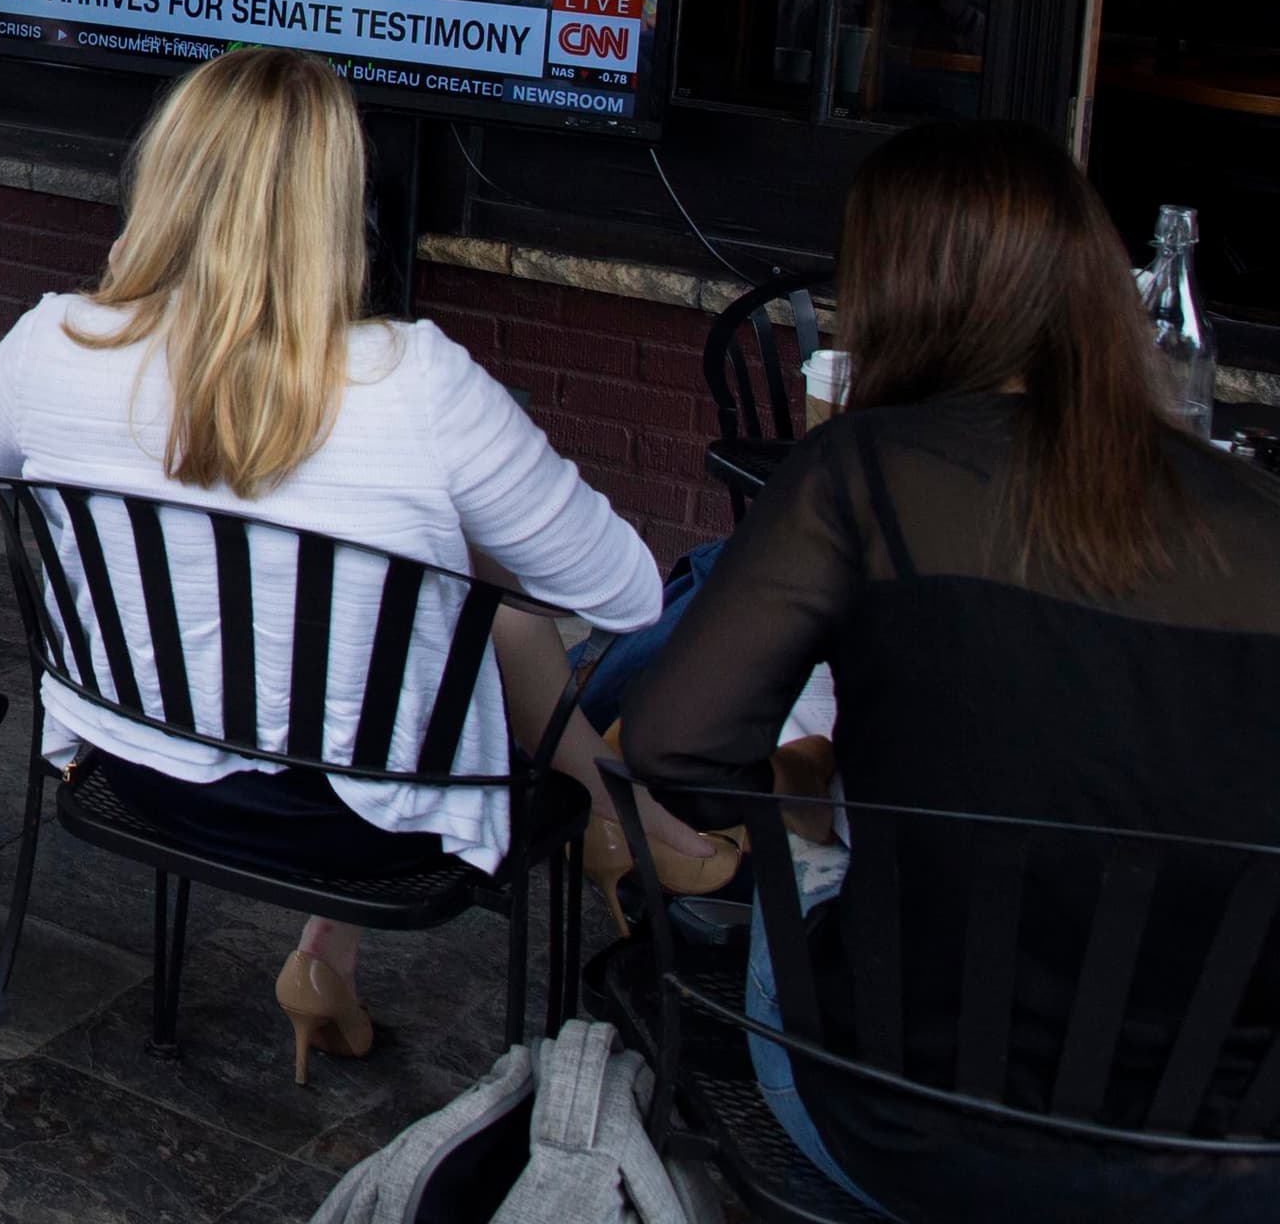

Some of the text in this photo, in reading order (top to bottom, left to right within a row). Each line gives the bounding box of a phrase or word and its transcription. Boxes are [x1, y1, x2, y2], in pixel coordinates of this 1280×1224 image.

[352, 6, 531, 56] TESTIMONY
[557, 22, 629, 61] CNN
[77, 31, 160, 55] CONSUMER
[164, 42, 225, 60] FINANC
[353, 65, 421, 88] BUREAU
[426, 75, 504, 98] CREATED
[551, 67, 627, 85] NAS -0.78
[512, 85, 624, 113] NEWSROOM
